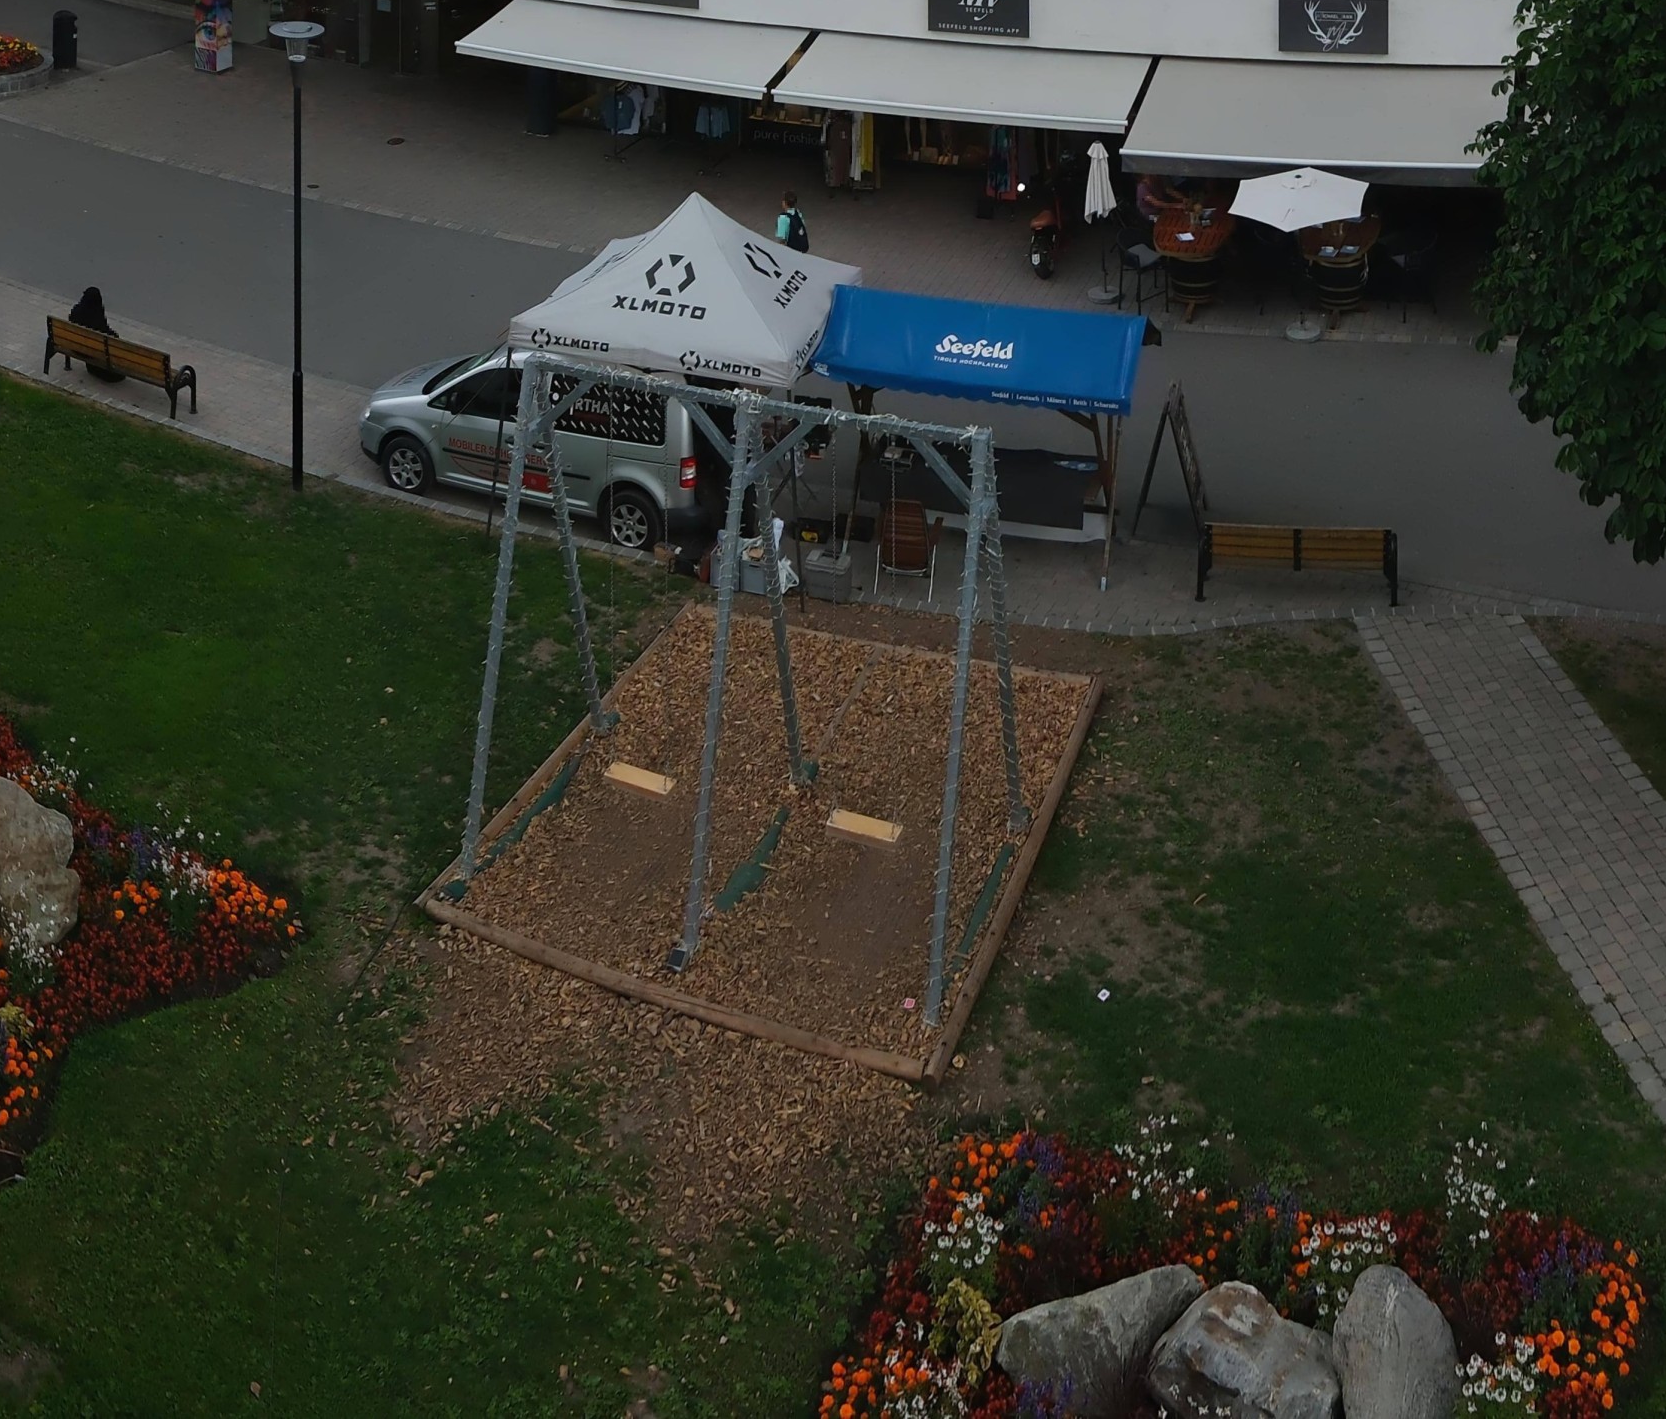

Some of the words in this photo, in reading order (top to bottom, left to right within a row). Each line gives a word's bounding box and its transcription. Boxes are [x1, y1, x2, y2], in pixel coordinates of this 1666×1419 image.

[938, 22, 966, 30] SEEFELD
[969, 24, 1004, 33] SHOPPING
[1007, 27, 1020, 35] APP
[611, 295, 707, 320] XLMOTO
[553, 335, 609, 352] XLMOTO
[935, 333, 1015, 361] Seefeld
[702, 359, 761, 377] XLMOTO
